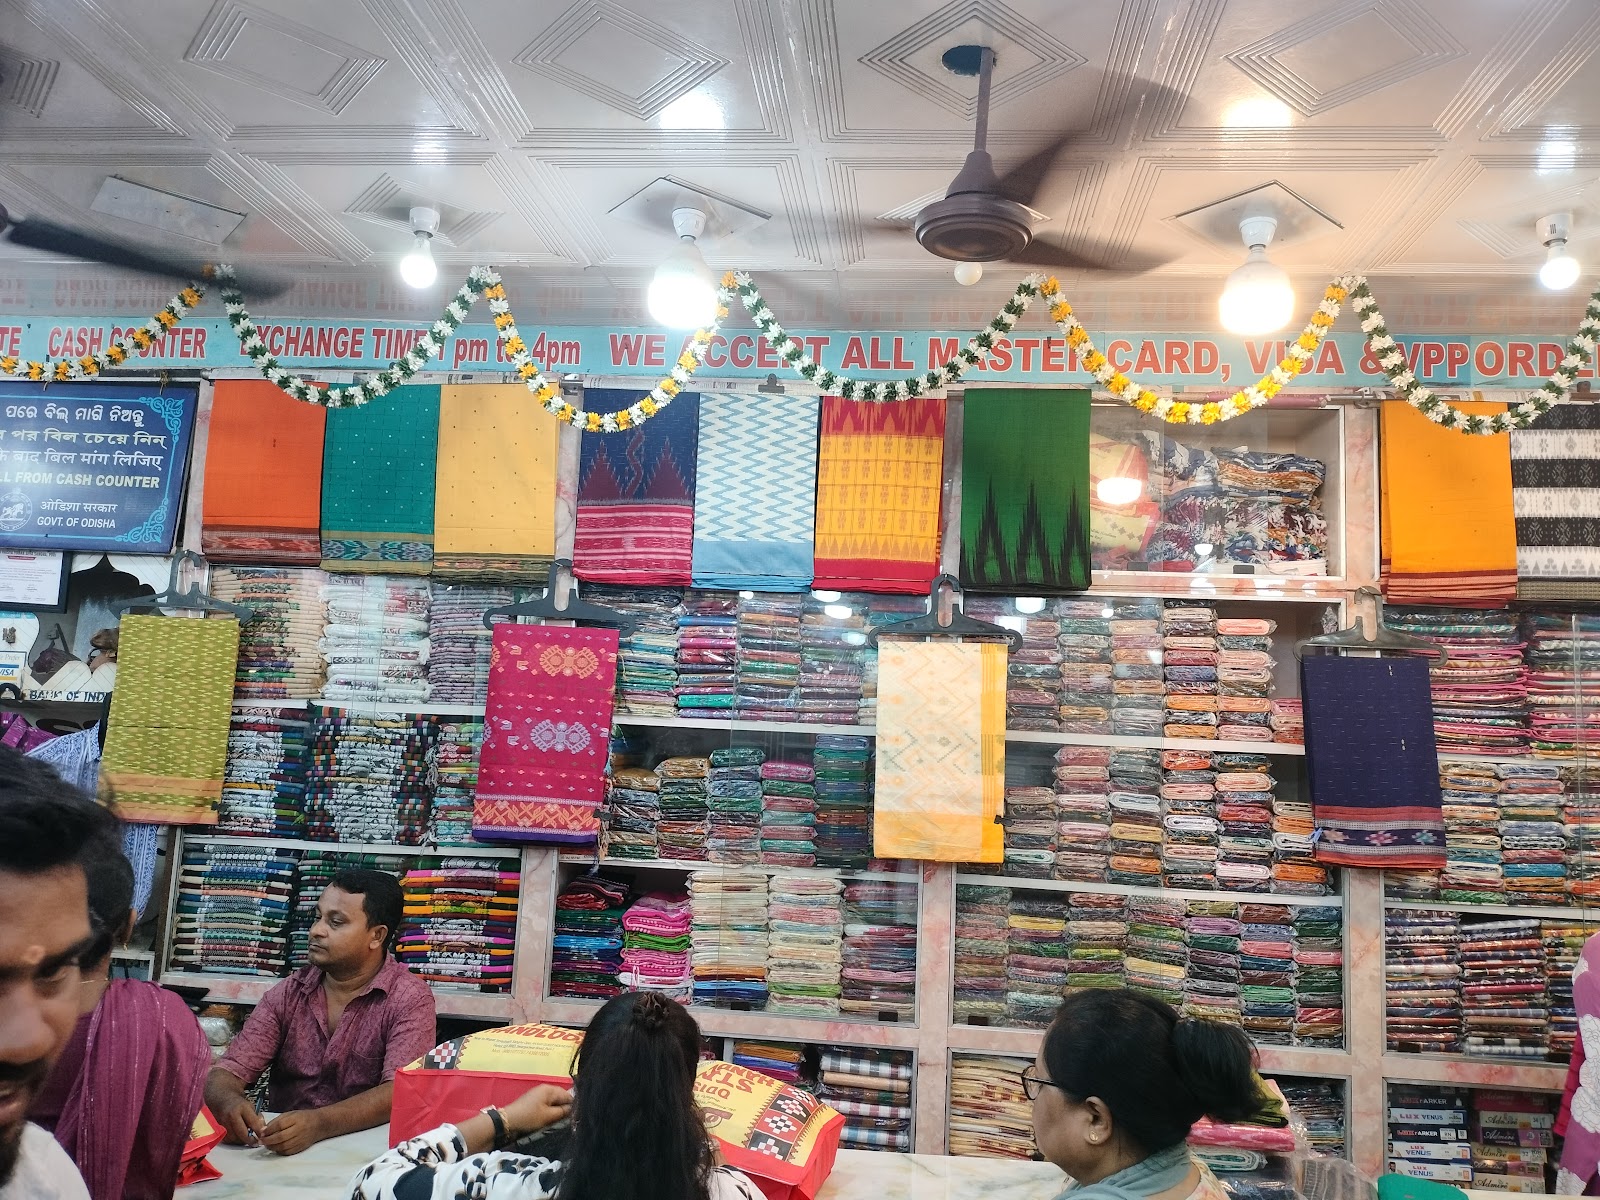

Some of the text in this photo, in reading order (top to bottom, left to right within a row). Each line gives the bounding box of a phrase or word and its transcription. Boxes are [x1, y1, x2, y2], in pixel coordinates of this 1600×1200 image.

[49, 327, 103, 357] CASH
[454, 337, 488, 369] pm
[532, 332, 581, 371] 4pm
[609, 334, 666, 366] WE
[840, 337, 914, 369] ALL
[1106, 339, 1232, 382] CARD,
[1474, 341, 1600, 379] ORD
[11, 429, 40, 442] পর
[43, 427, 79, 443] বিল
[12, 450, 42, 464] बाद
[44, 447, 78, 464] बिल
[80, 450, 110, 466] मांग
[113, 450, 164, 472] लिजिए
[15, 472, 53, 484] FROM
[56, 473, 93, 487] CASH
[95, 474, 160, 489] COUNTER
[40, 499, 118, 513] ओडिशा सरकार
[36, 516, 116, 529] GOVT. OF ODISHA
[66, 691, 81, 700] OF
[1408, 1169, 1434, 1177] VENUS
